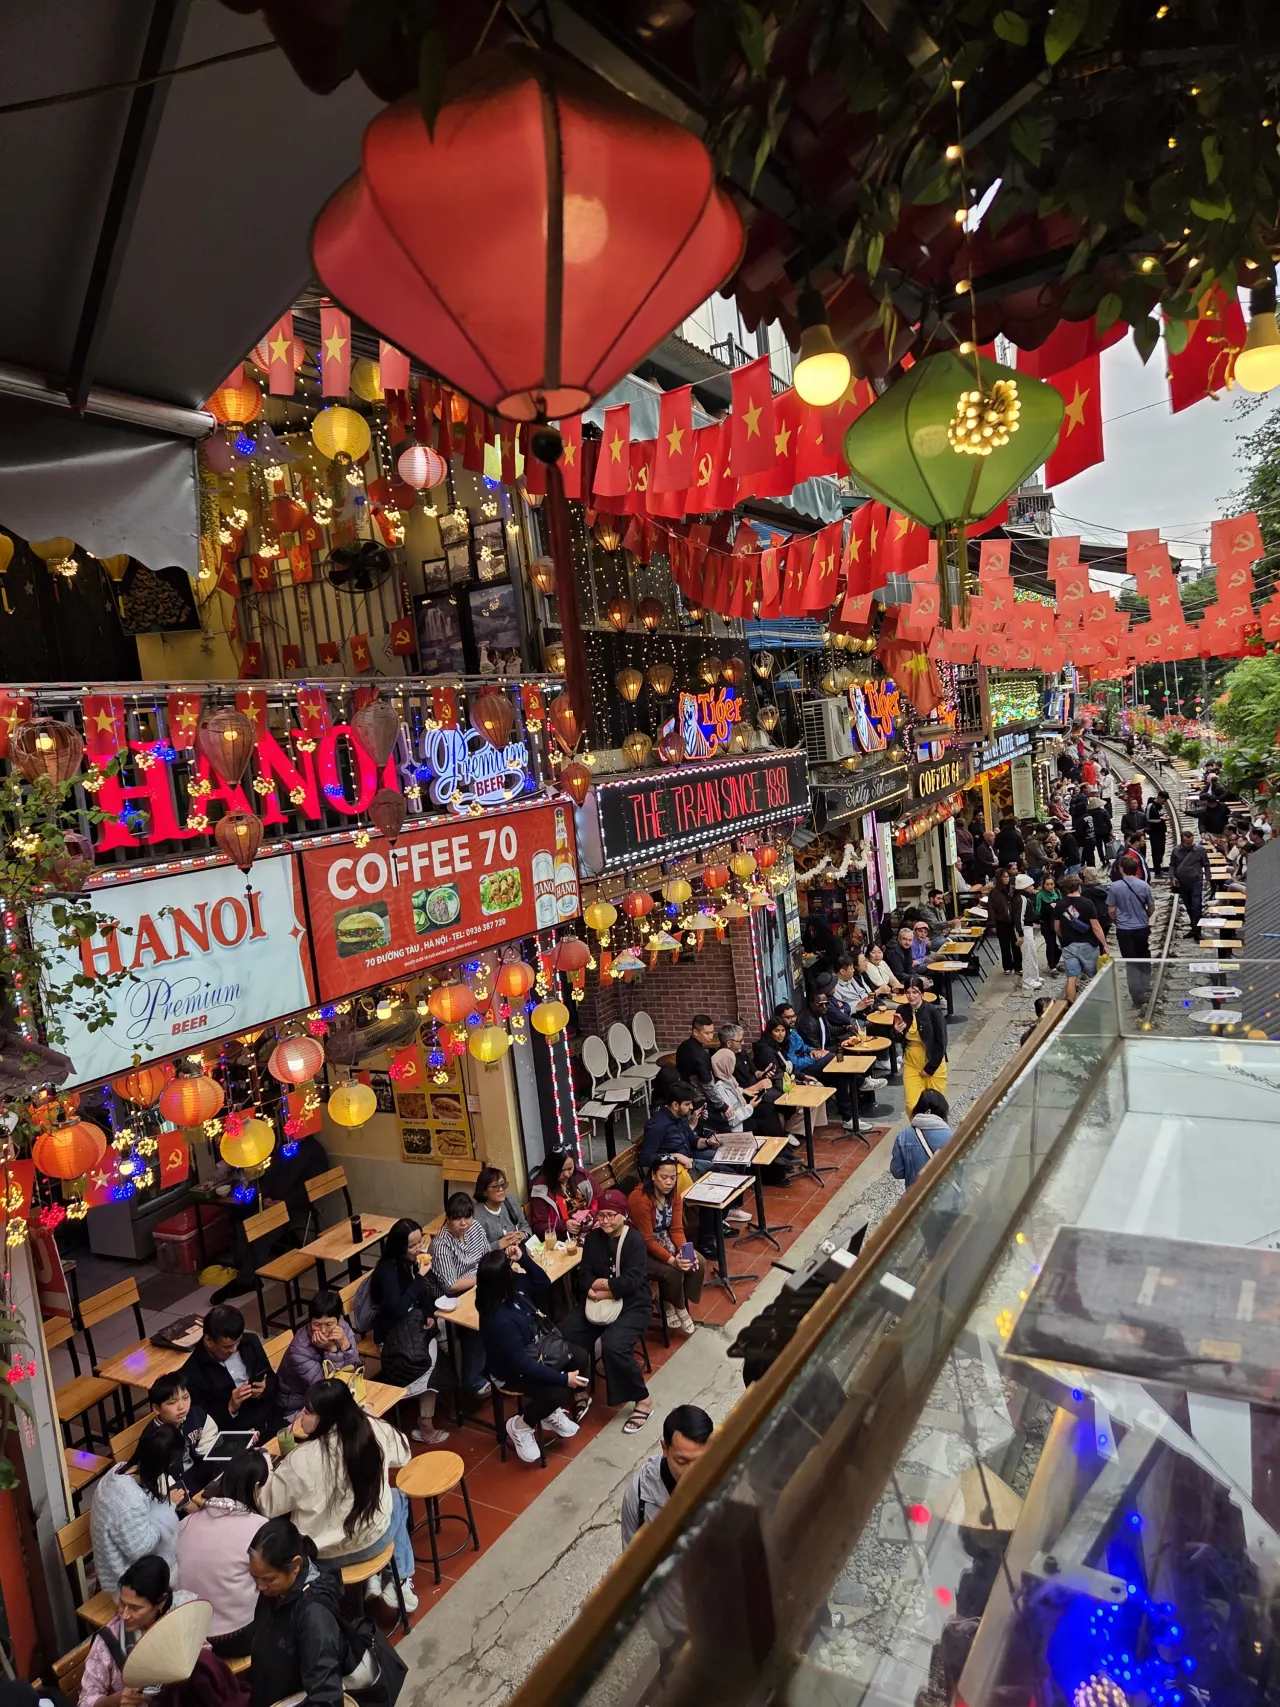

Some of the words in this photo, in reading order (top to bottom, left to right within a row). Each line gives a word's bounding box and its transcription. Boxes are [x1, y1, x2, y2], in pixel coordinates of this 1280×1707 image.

[698, 687, 742, 740] Tiger
[864, 679, 900, 734] Tiger
[475, 775, 505, 797] BEER
[845, 782, 870, 807] Sixty
[871, 777, 884, 799] Six
[919, 763, 951, 798] COFFEE
[951, 760, 960, 783] 64
[628, 788, 669, 844] THE
[670, 779, 722, 833] TRAIN
[721, 771, 763, 820] SINCE
[327, 834, 473, 901] COFFEE
[478, 825, 518, 867] 70
[75, 890, 268, 979] HANOI
[365, 958, 376, 968] 70
[376, 947, 405, 965] ĐƯỜNG
[405, 943, 421, 956] TÀU
[424, 938, 437, 951] HÀ
[436, 933, 448, 950] NỘI
[452, 931, 466, 942] TEL:
[466, 925, 482, 937] 0936
[482, 921, 494, 932] 387
[495, 917, 507, 927] 720
[125, 976, 243, 1040] Premium
[171, 1014, 208, 1037] BEER
